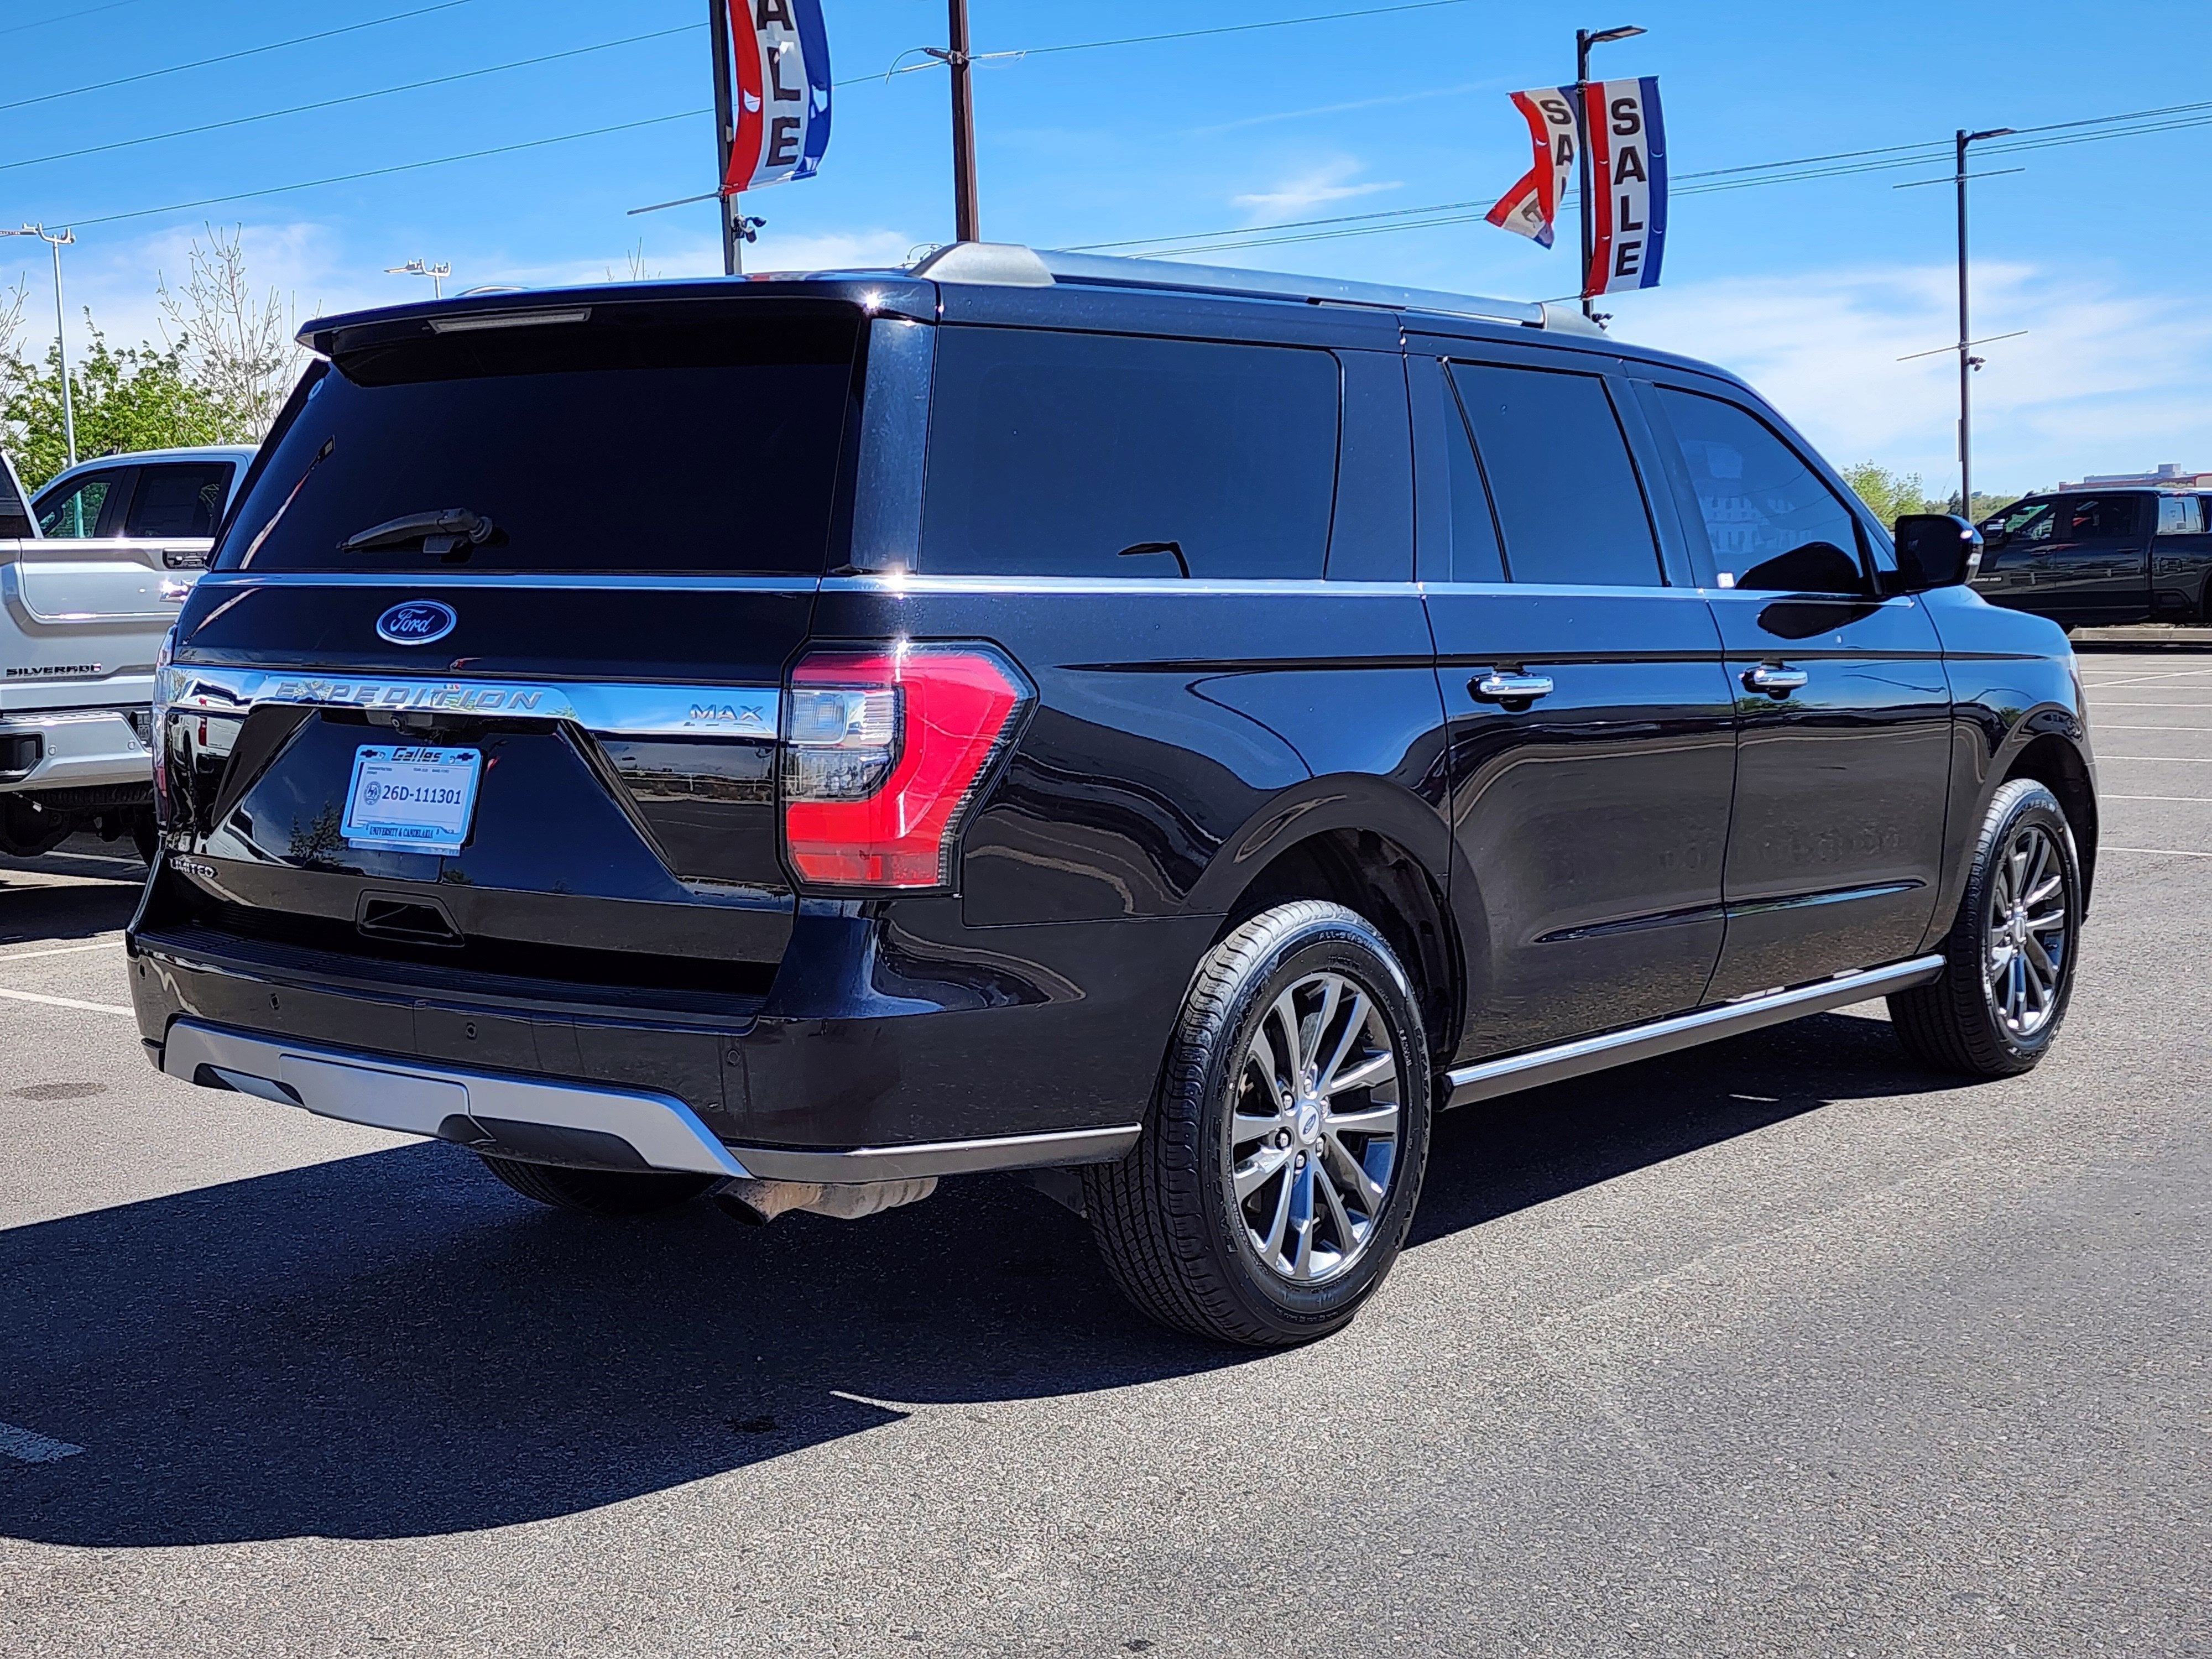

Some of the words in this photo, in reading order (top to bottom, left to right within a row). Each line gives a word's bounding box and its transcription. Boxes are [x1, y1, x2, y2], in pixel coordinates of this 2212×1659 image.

[1611, 97, 1646, 277] SALE
[390, 608, 435, 633] Ford
[6, 663, 102, 677] SILVERADO
[275, 681, 542, 710] EXPEDITION
[690, 703, 764, 721] MAX
[382, 785, 462, 805] 26D-111301
